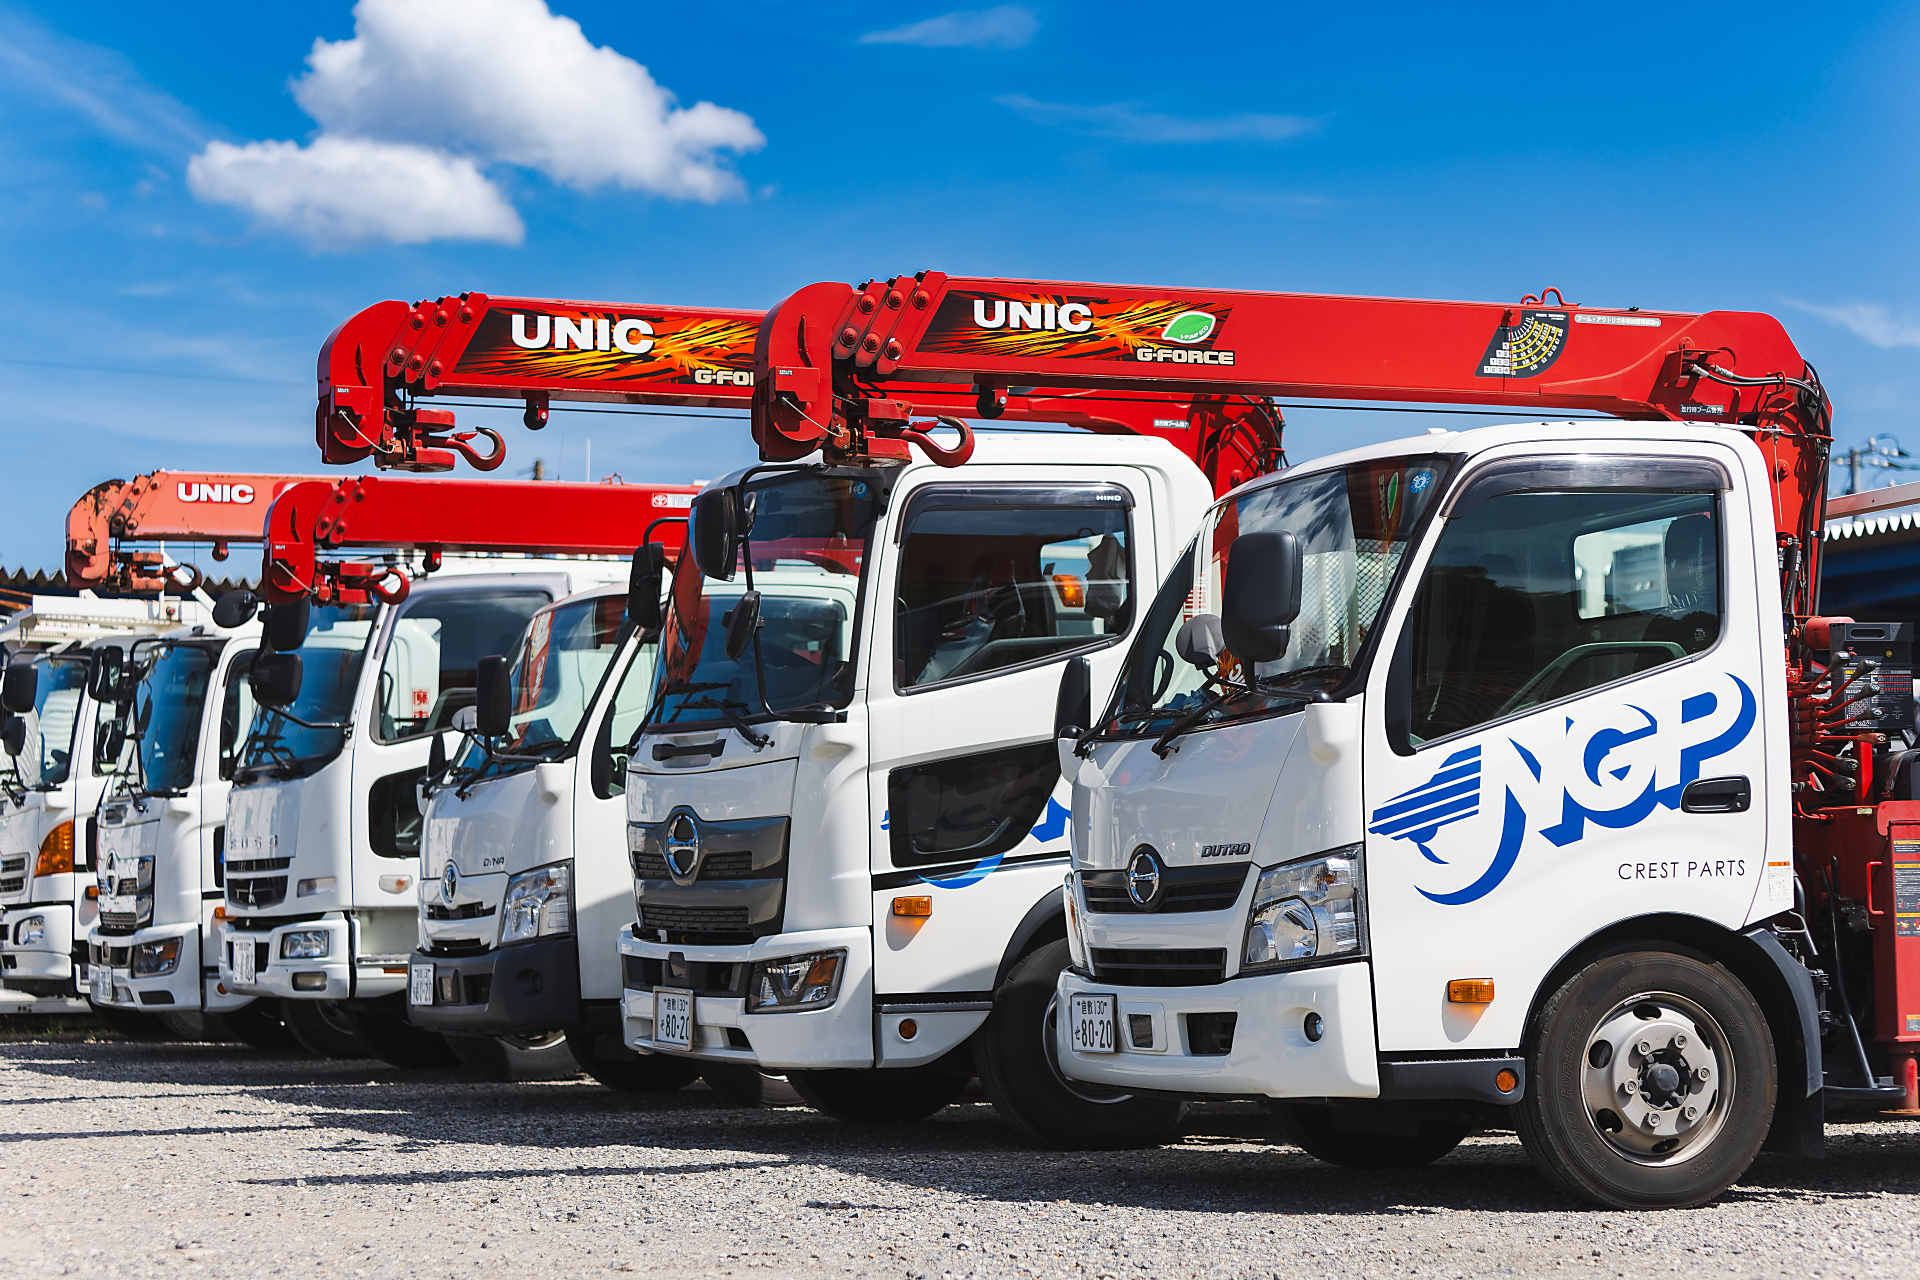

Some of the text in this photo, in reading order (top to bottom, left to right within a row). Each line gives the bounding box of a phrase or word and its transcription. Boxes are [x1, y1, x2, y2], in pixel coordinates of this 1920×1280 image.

[974, 299, 1092, 332] UNIC
[511, 314, 654, 353] UNIC
[1137, 348, 1235, 365] G-FORCE
[177, 483, 254, 504] UNIC
[1368, 672, 1757, 905] NGP
[1201, 843, 1251, 857] DUTRO
[1618, 860, 1746, 879] CREST PARTS
